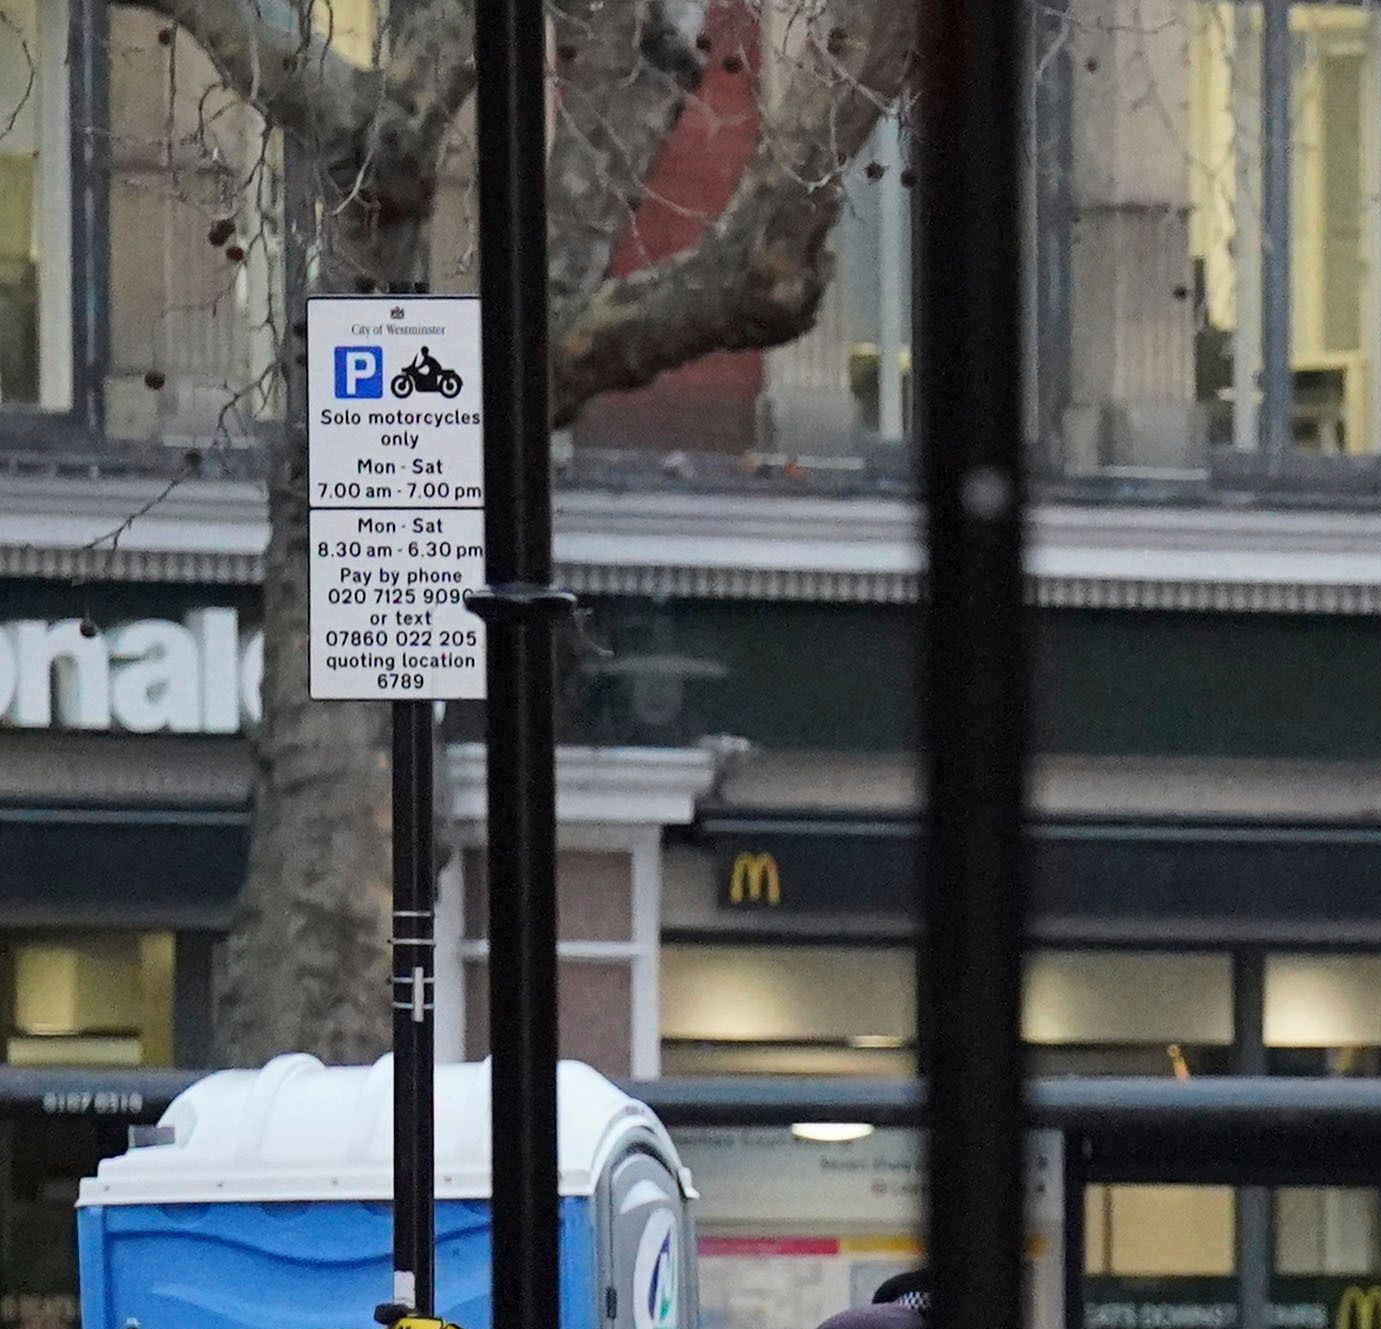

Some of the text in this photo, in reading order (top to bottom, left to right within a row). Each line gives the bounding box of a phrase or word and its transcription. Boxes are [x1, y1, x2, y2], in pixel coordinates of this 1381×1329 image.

[351, 324, 446, 338] City of Westminster
[345, 351, 377, 396] P
[320, 409, 481, 428] Solo motorcycles
[380, 431, 420, 449] only
[357, 459, 396, 474] Mon
[412, 458, 444, 474] Sat
[318, 482, 361, 499] 7.00
[365, 486, 392, 499] am
[406, 482, 450, 499] 7.00
[454, 486, 482, 501] pm
[357, 517, 396, 533] Mon
[411, 517, 444, 533] Sat
[317, 541, 362, 558] 8.30
[366, 545, 393, 558] am
[407, 541, 451, 558] 6.30
[456, 545, 483, 560] pm
[340, 567, 463, 586] Pay by phone
[328, 588, 367, 605] 020
[374, 588, 416, 605] 7125
[369, 610, 432, 626] or text
[325, 630, 477, 647] 07860 022 205
[326, 653, 476, 671] quoting location
[377, 673, 424, 689] 6789
